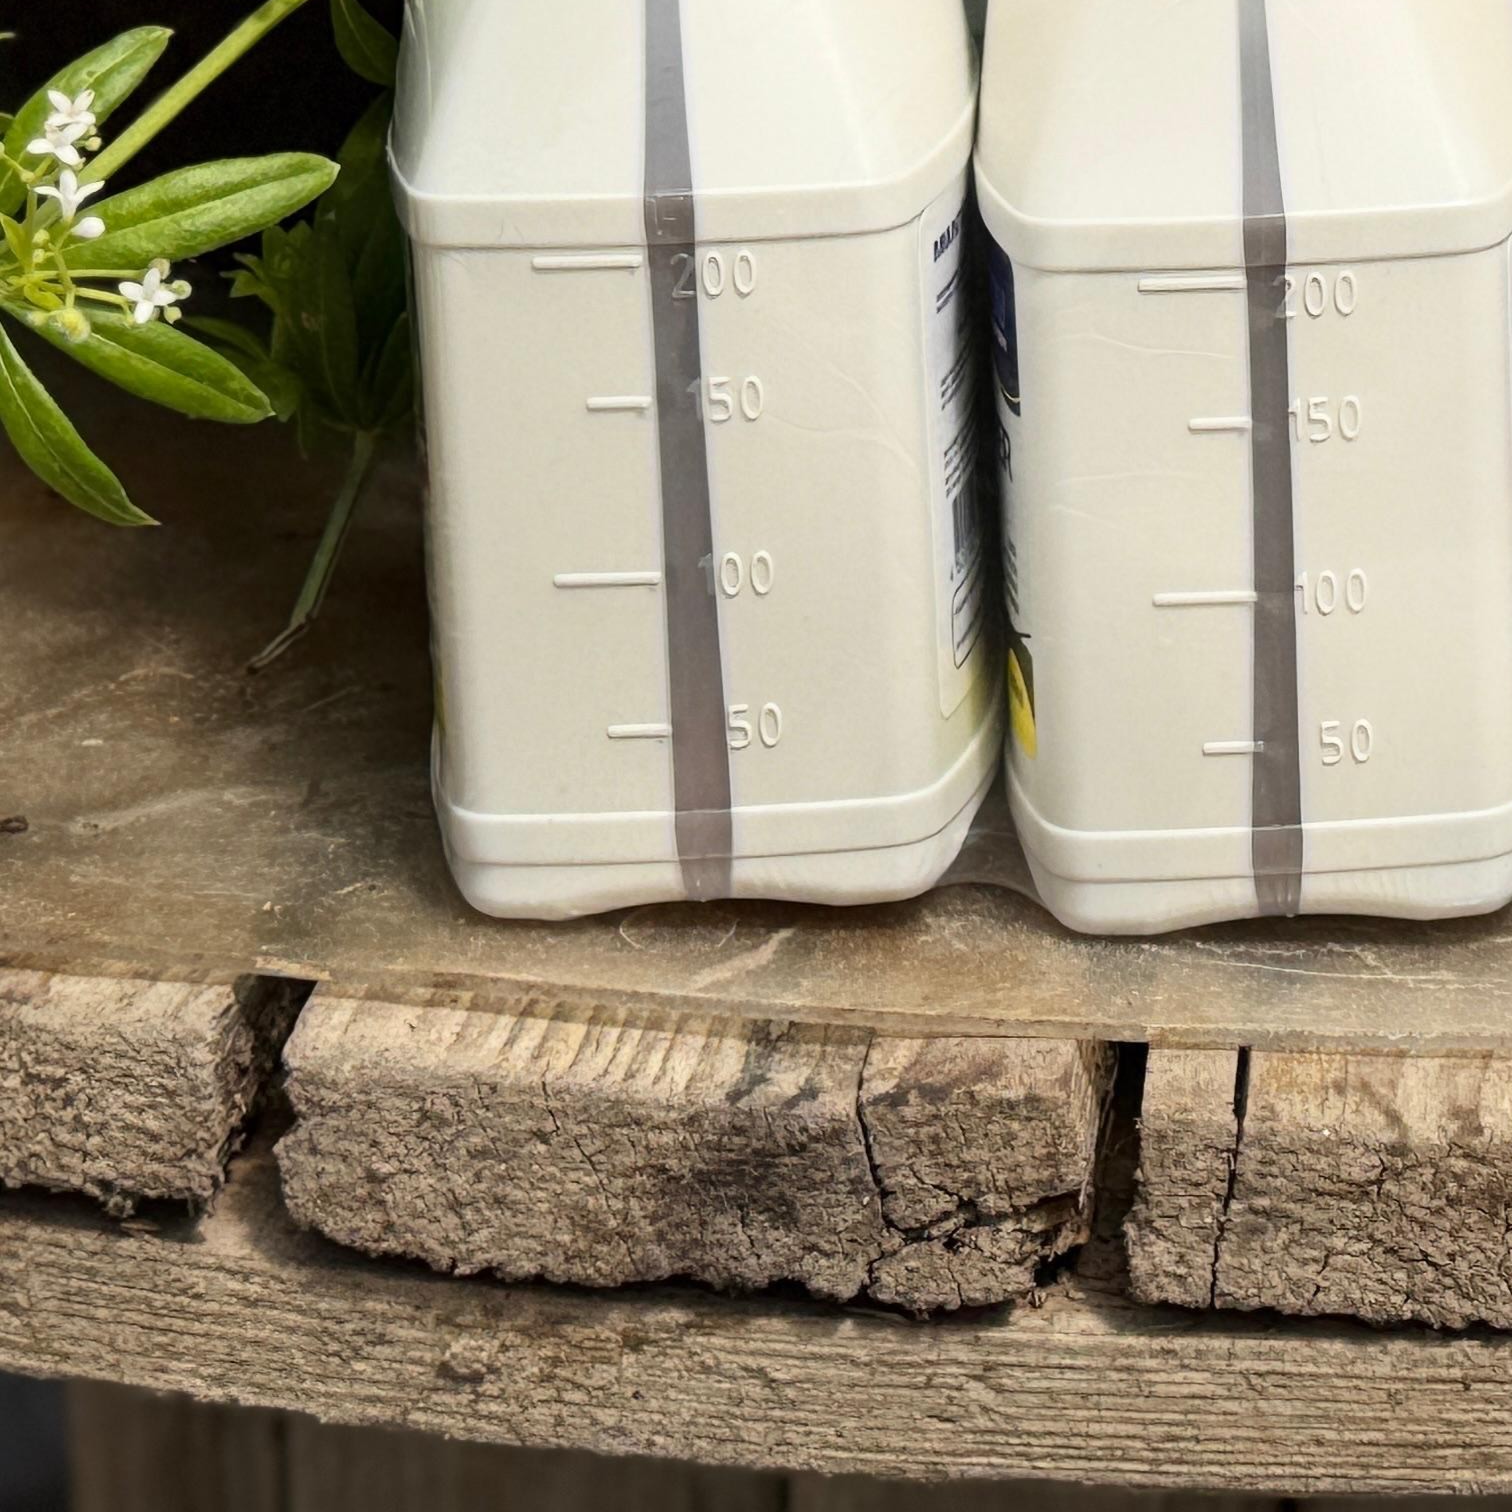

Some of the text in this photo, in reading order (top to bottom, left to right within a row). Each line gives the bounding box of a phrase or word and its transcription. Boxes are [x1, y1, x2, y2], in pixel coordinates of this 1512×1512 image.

[669, 248, 758, 300] 200
[1273, 270, 1358, 318] 200
[726, 702, 783, 749] 50
[1320, 718, 1374, 766] 50
